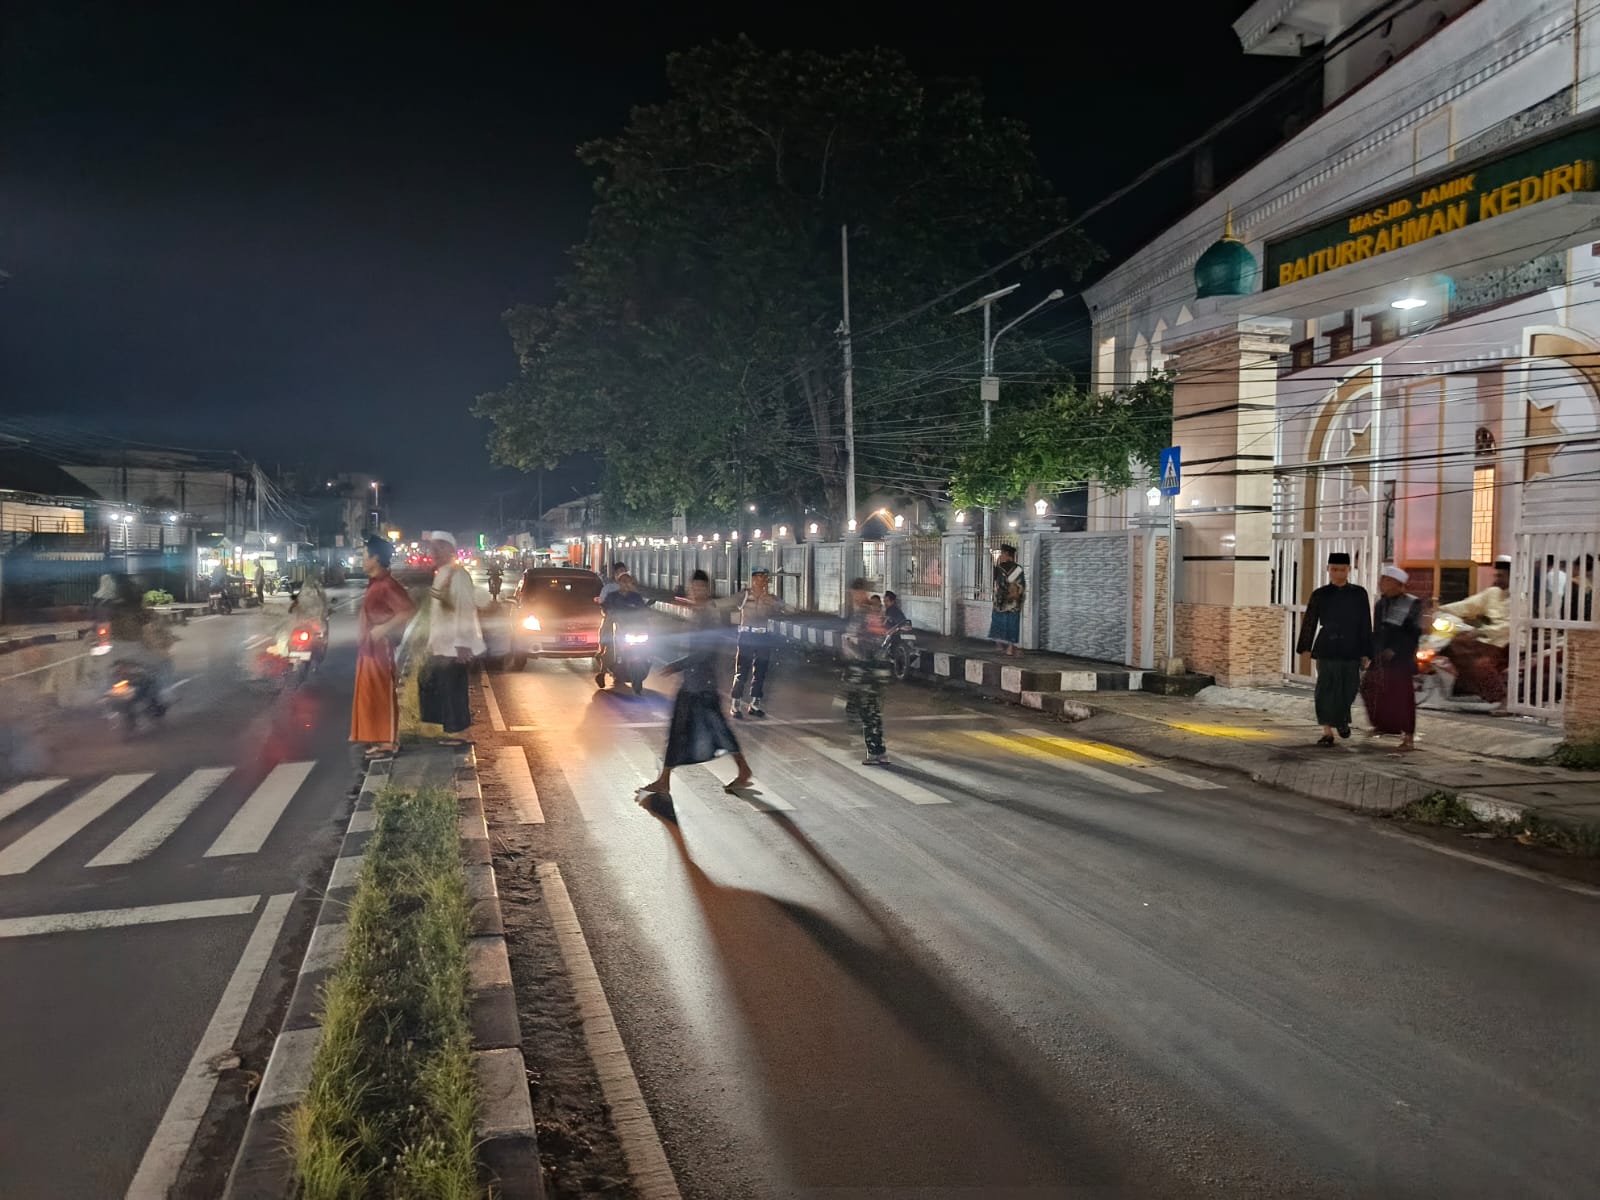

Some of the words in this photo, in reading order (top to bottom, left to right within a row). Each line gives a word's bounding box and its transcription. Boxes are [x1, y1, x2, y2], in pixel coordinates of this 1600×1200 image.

[1279, 200, 1467, 286] BAITURRAHMAN
[1480, 160, 1584, 220] KEDIRI
[1349, 200, 1412, 233] MASJID
[1417, 175, 1475, 208] JAMIK
